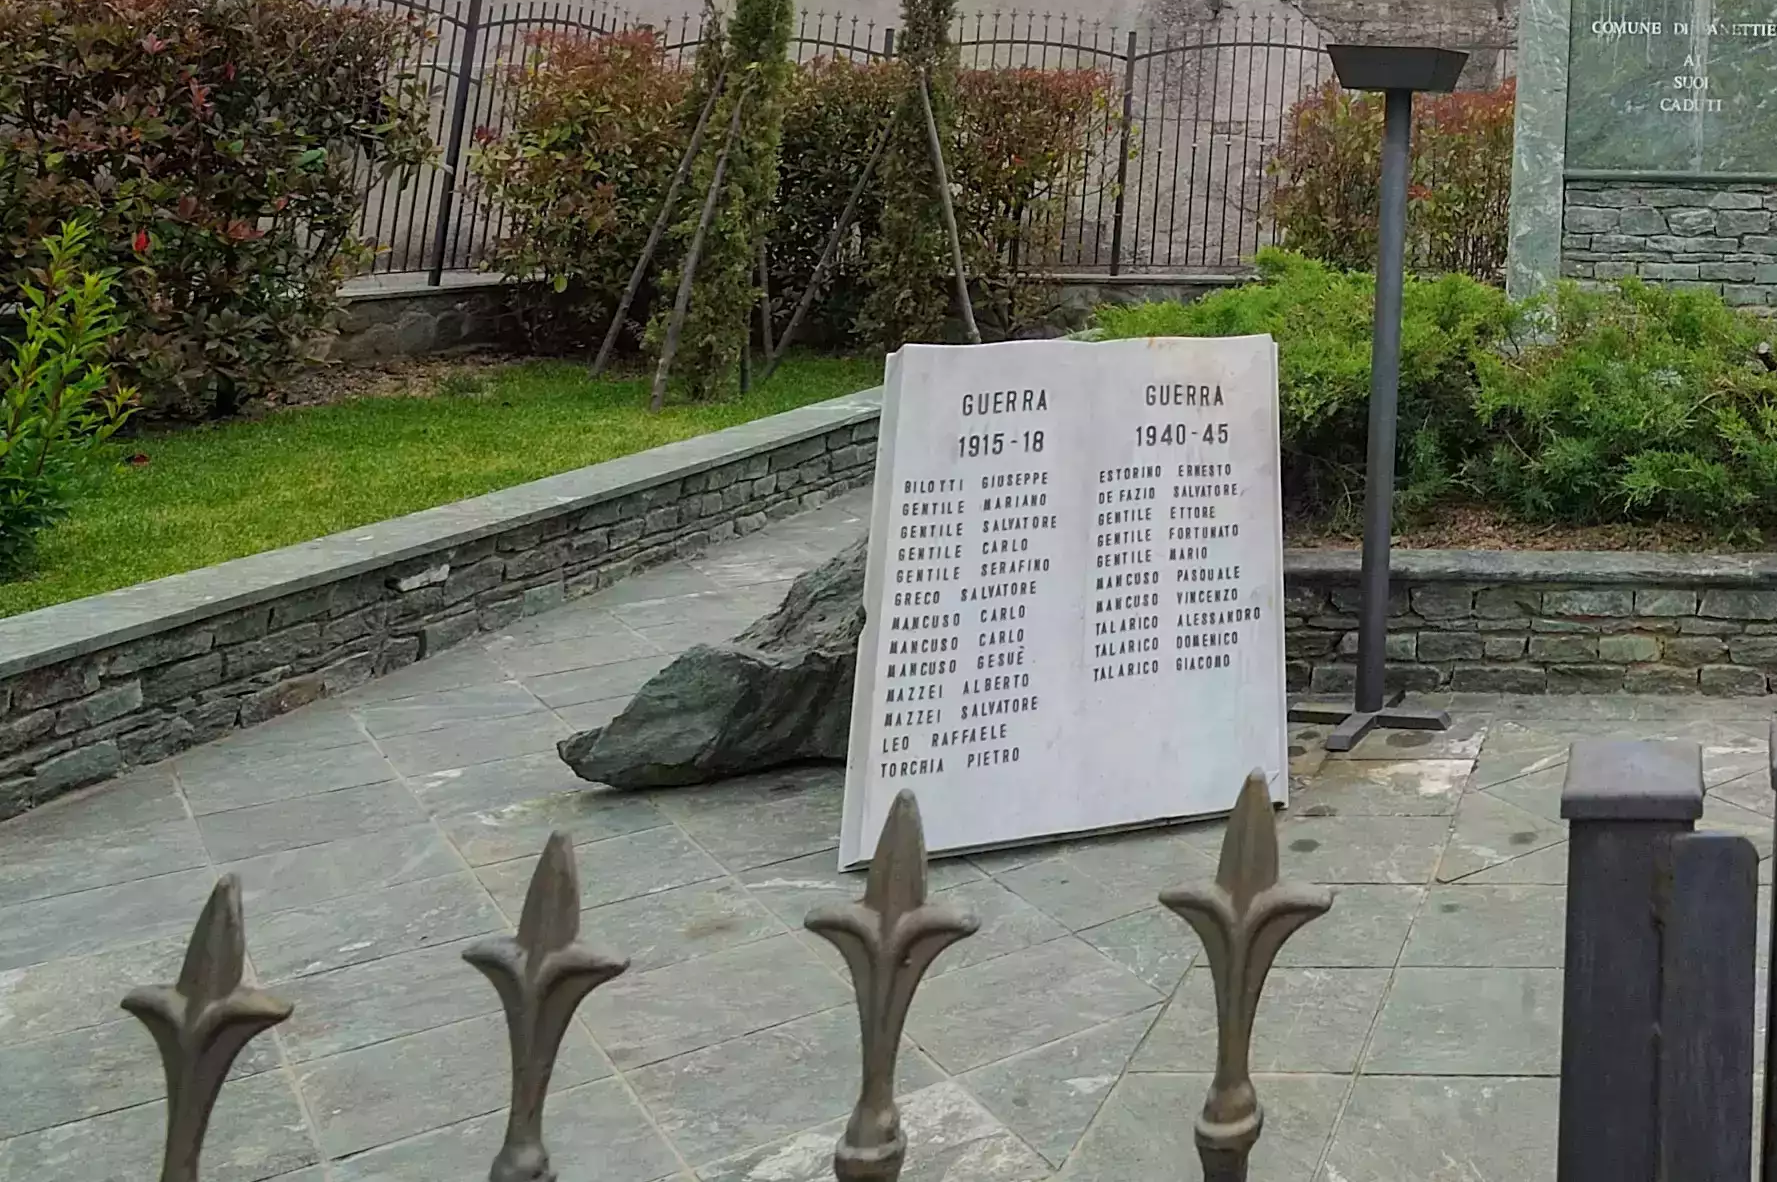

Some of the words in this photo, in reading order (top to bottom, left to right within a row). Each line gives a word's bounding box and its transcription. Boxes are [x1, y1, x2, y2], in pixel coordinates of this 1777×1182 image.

[1592, 21, 1661, 35] COMUNE
[1674, 22, 1689, 35] DI
[1683, 54, 1701, 66] AI
[1674, 76, 1708, 89] SUOI
[1660, 98, 1722, 112] CADUTI
[962, 389, 1047, 416] GUERRA
[1146, 384, 1224, 406] GUERRA
[904, 479, 963, 494] BILOTTI
[982, 472, 1048, 489] GIUSEPPE
[1100, 466, 1161, 483] ESTORINO
[1178, 464, 1232, 477] ERNESTO
[902, 501, 965, 516] GENTILE
[983, 494, 1047, 511] MARIANO
[1099, 492, 1112, 504] DE
[1119, 487, 1155, 502] FAZIO
[1173, 483, 1238, 498] SALVATORE
[901, 523, 963, 539] GENTILE
[982, 516, 1057, 533] SALVATORE
[1098, 508, 1152, 526] GENTILE
[1170, 506, 1215, 519] ETTORE
[1097, 529, 1152, 547] GENTILE
[1169, 524, 1239, 540] FORTUNATO
[899, 545, 962, 561] GENTILE
[982, 538, 1028, 555] CARLO
[1097, 549, 1152, 568] GENTILE
[1169, 547, 1208, 560] MARIO
[897, 567, 960, 583] GENTILE
[981, 558, 1050, 576] SERAFINO
[1096, 571, 1159, 590] MANCUSO
[1177, 566, 1240, 582] PASQUALE
[895, 591, 940, 606] GRECO
[961, 581, 1037, 602] SALVATORE
[1096, 593, 1158, 613] MANCUSO
[1177, 588, 1238, 604] VINCENZO
[891, 613, 960, 630] MANCUSO
[980, 605, 1026, 623] CARLO
[1096, 616, 1158, 636] TALARICO
[1177, 607, 1260, 627] ALESSANDRO
[889, 637, 958, 654] MANCUSO
[979, 629, 1024, 646] CARLO
[1095, 637, 1158, 657] TALARICO
[1176, 631, 1238, 649] DOMENICO
[887, 659, 956, 678] MANCUSO
[1094, 660, 1158, 682] TALARICO
[1176, 654, 1230, 671] GIACOMO
[886, 685, 943, 702] MAZZEI
[963, 673, 1029, 695] ALBERTO
[884, 709, 941, 727] MAZZEI
[961, 696, 1038, 720] SALVATORE
[883, 736, 910, 753] LEO
[931, 724, 1008, 747] RAFFAELE
[881, 758, 944, 778] TORCHIA
[967, 747, 1020, 768] PIETRO
